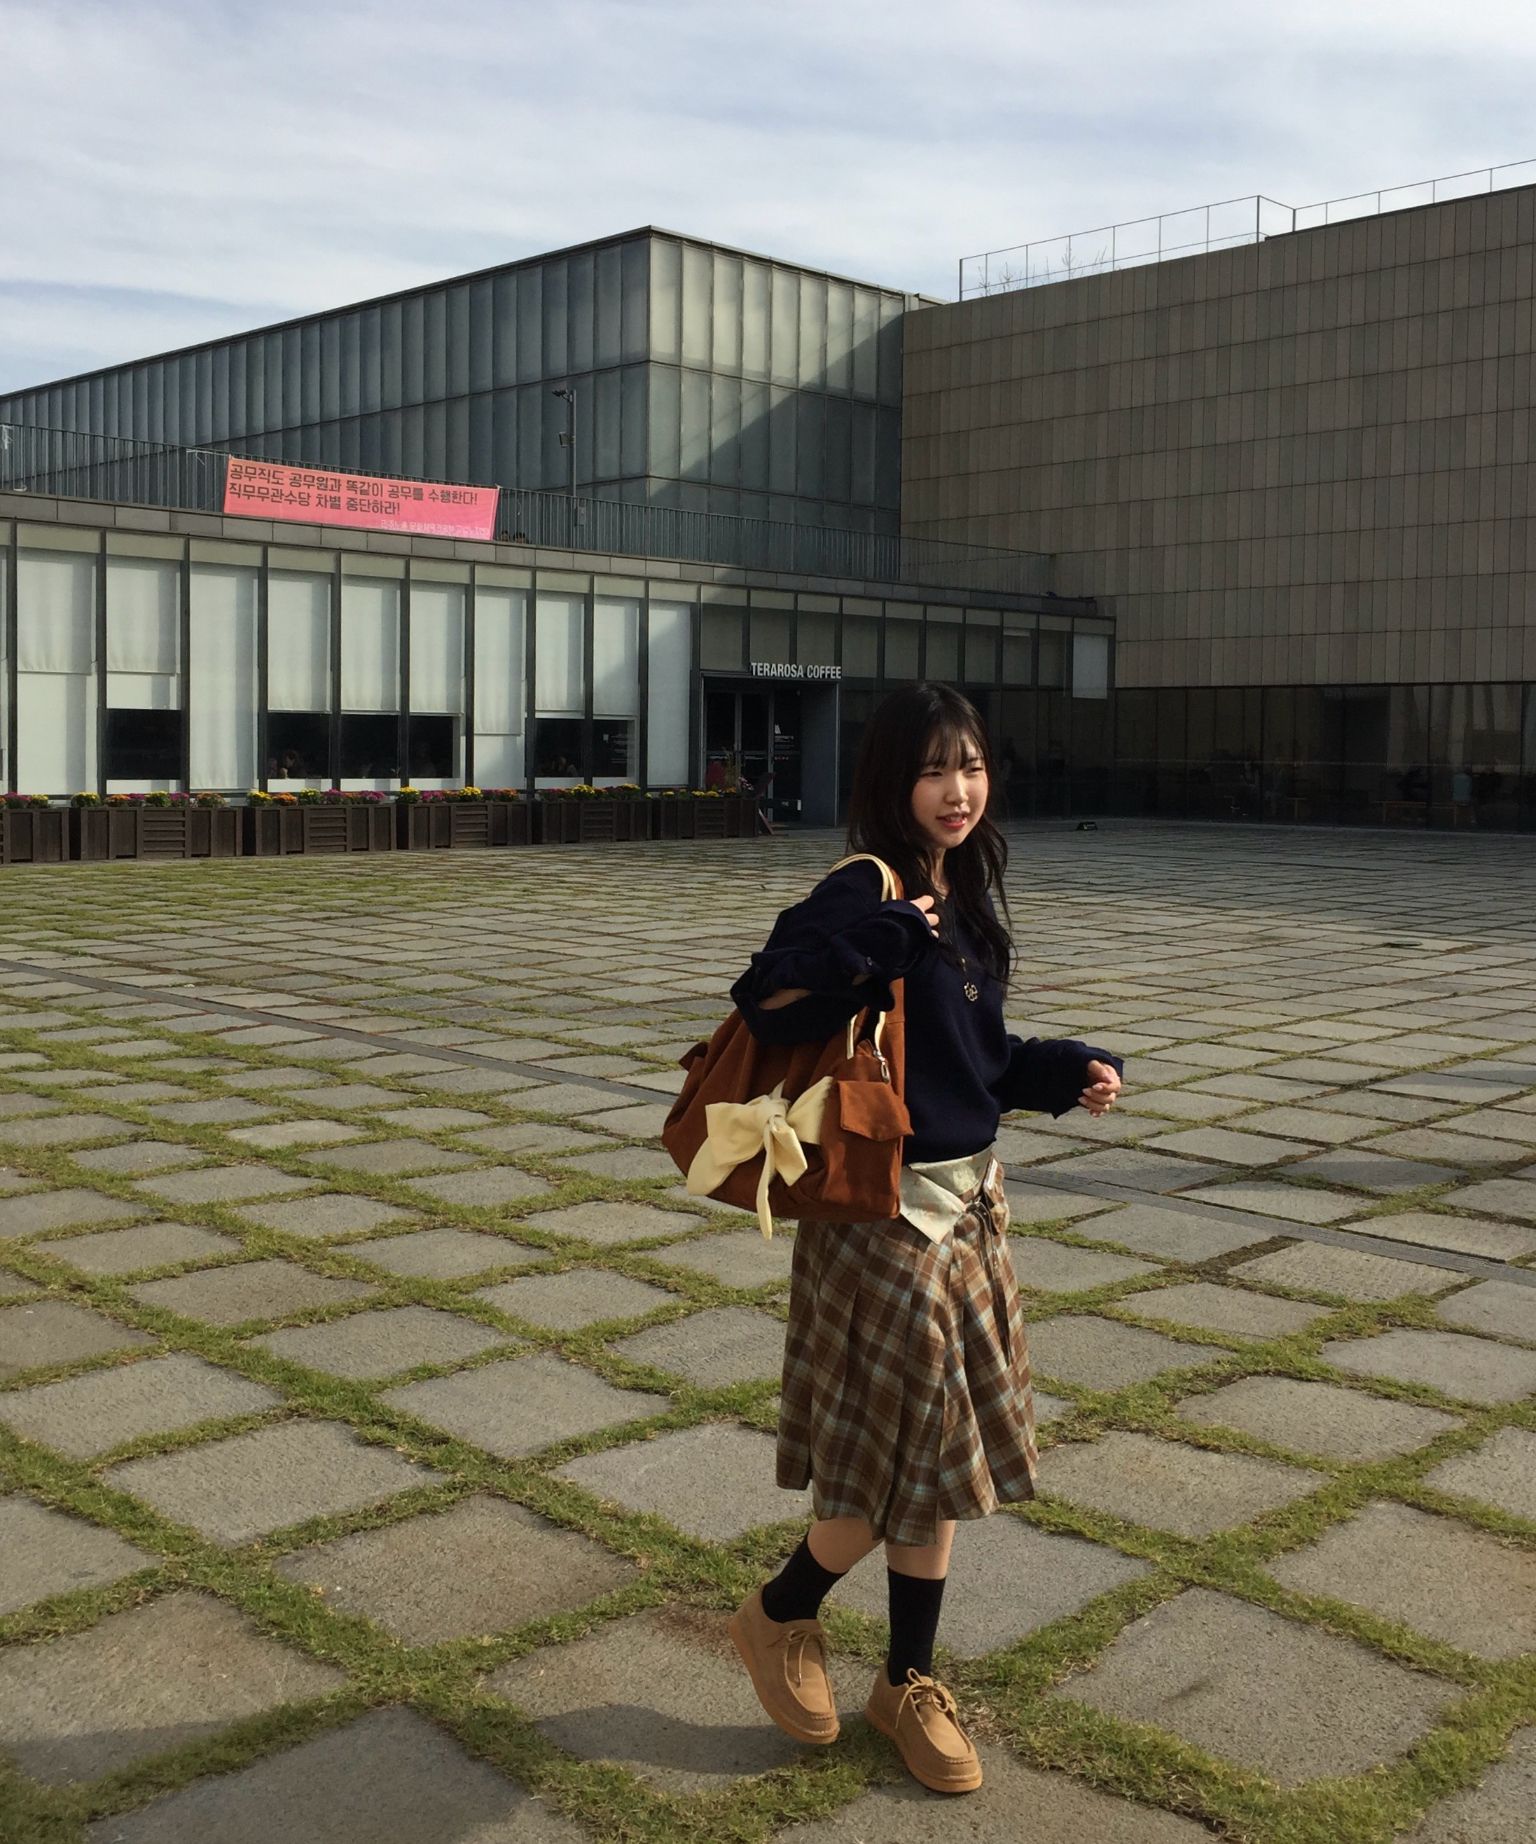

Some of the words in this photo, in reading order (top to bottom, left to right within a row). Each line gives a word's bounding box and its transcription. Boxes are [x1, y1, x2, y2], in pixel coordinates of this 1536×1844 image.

[229, 482, 311, 506] 직무무관수당
[315, 494, 341, 510] 차별
[346, 498, 400, 515] 중단하라!
[230, 464, 284, 485] 공무직도
[289, 472, 342, 492] 공무원과
[346, 480, 383, 497] 똑같이
[387, 484, 424, 501] 공무를
[429, 489, 478, 505] 수행한다!
[751, 662, 804, 678] TERAROSA
[806, 665, 842, 679] COFFEE
